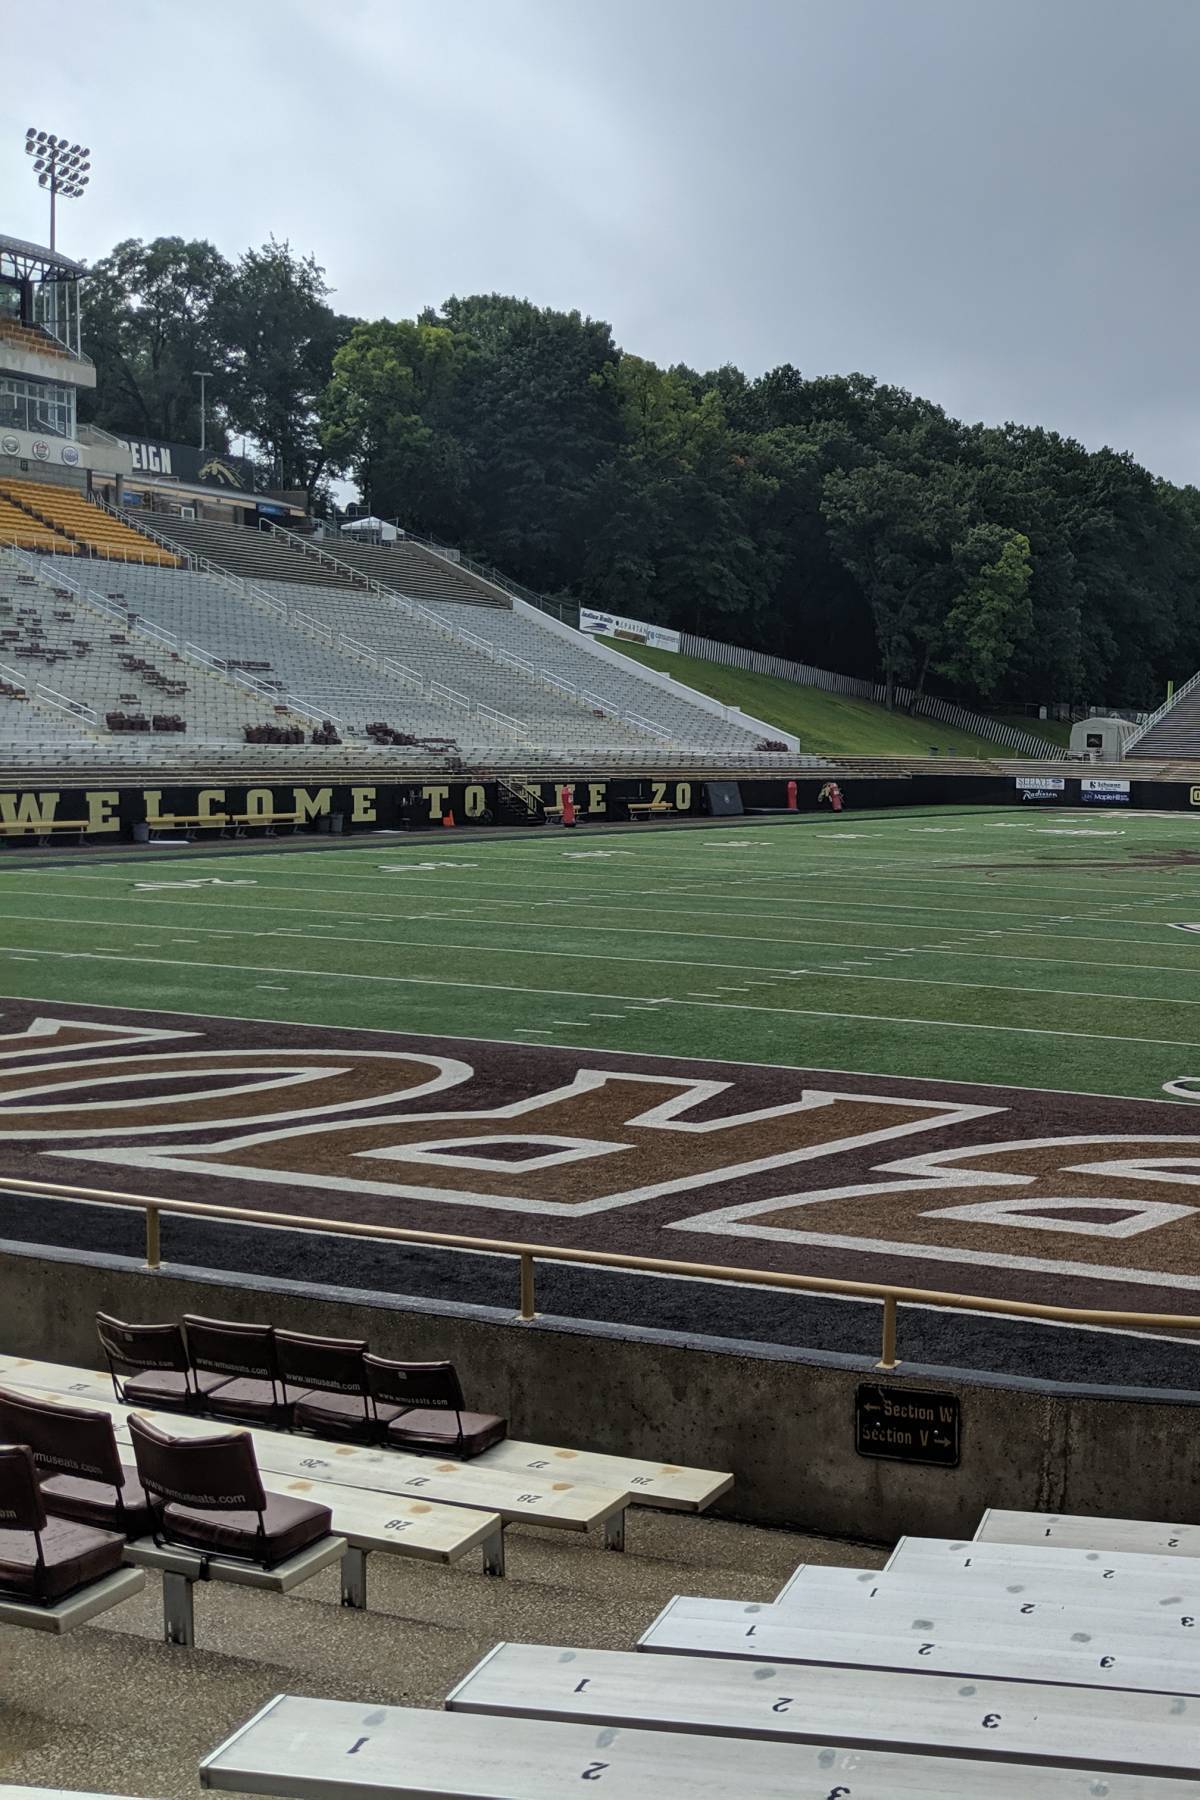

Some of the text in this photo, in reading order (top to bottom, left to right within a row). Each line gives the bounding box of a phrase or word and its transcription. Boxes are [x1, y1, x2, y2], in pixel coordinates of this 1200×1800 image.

[422, 784, 486, 820] TO
[1022, 789, 1058, 801] Radisson
[286, 1371, 361, 1391] www.wmuseats.com
[883, 1400, 953, 1423] Section W
[863, 1423, 929, 1447] Section V
[1167, 1538, 1180, 1548] 2
[1102, 1569, 1115, 1579] 2
[1019, 1603, 1036, 1615] 2
[1180, 1616, 1195, 1628] 3
[917, 1643, 935, 1656] 2
[1099, 1655, 1116, 1669] 3
[772, 1697, 794, 1713] 2
[981, 1713, 1002, 1729] 3
[581, 1761, 610, 1781] 2
